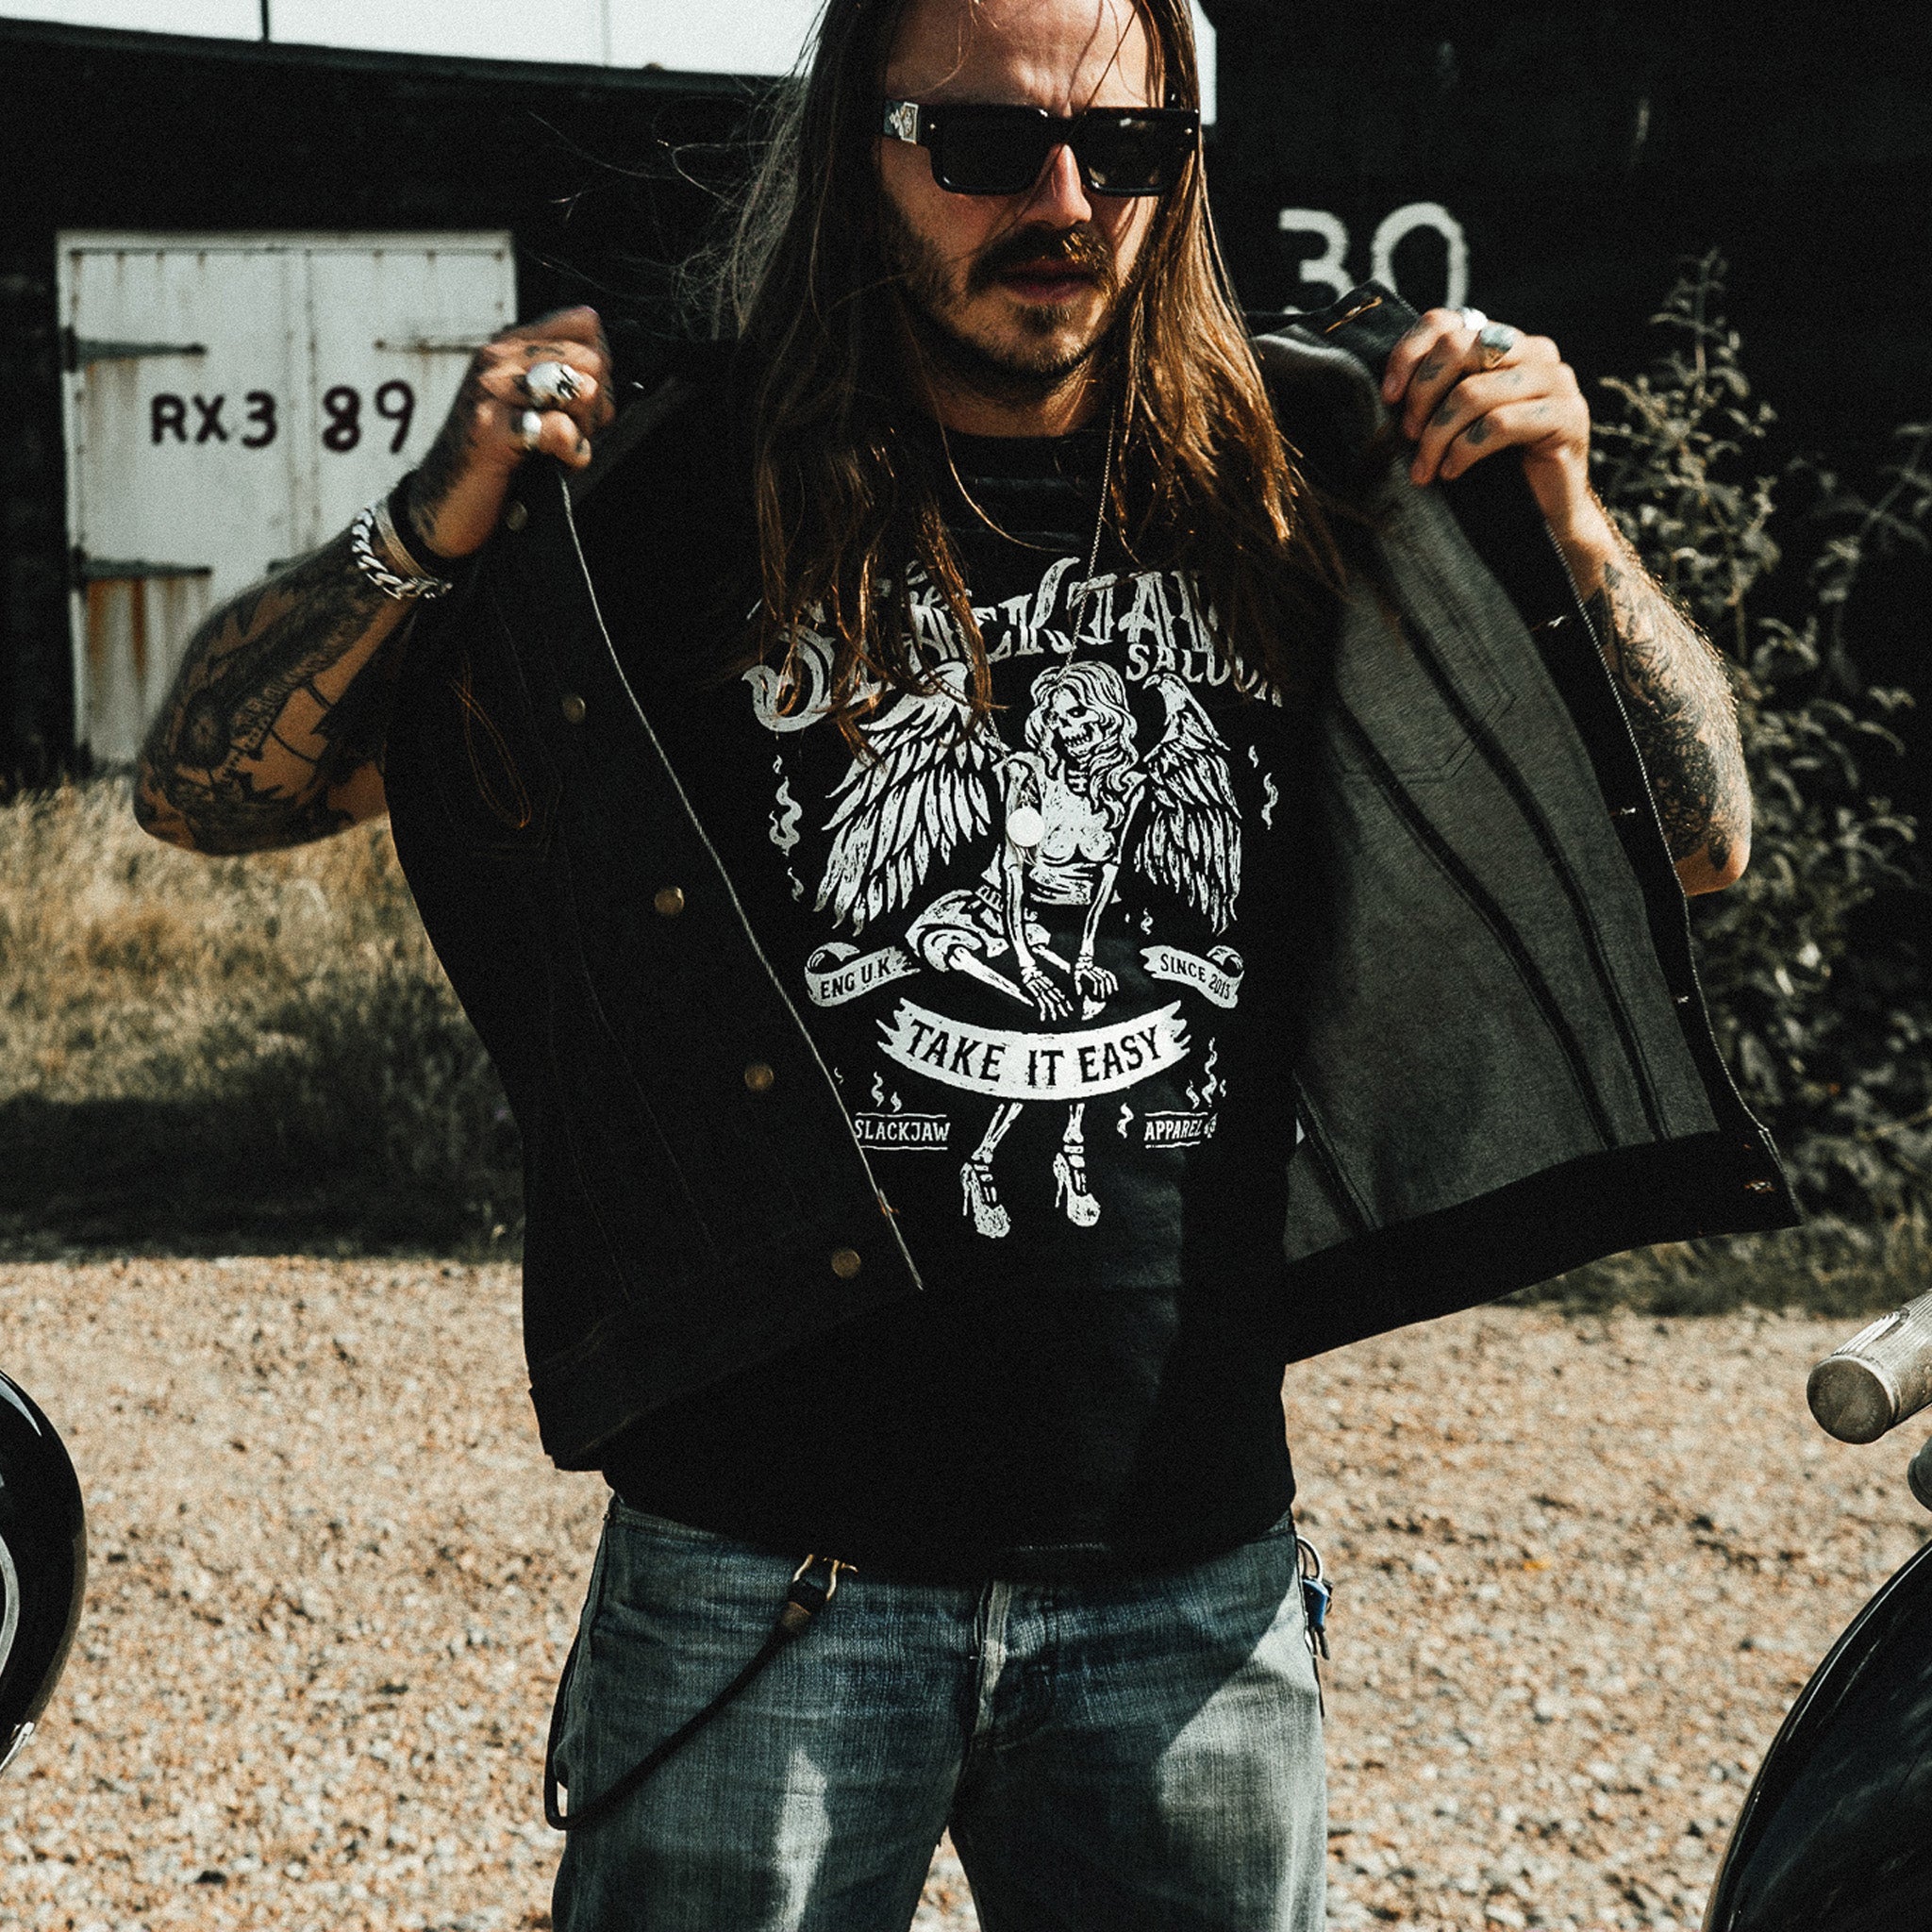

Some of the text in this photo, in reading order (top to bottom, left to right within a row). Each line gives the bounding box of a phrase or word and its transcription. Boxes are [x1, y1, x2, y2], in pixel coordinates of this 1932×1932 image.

[322, 379, 415, 454] 89
[1159, 953, 1207, 983] SINCE
[820, 973, 855, 1000] ENG
[907, 1019, 1162, 1087] TAKE IT EASY
[854, 1118, 952, 1142] SLACKJAW
[1142, 1119, 1204, 1142] APPAREL
